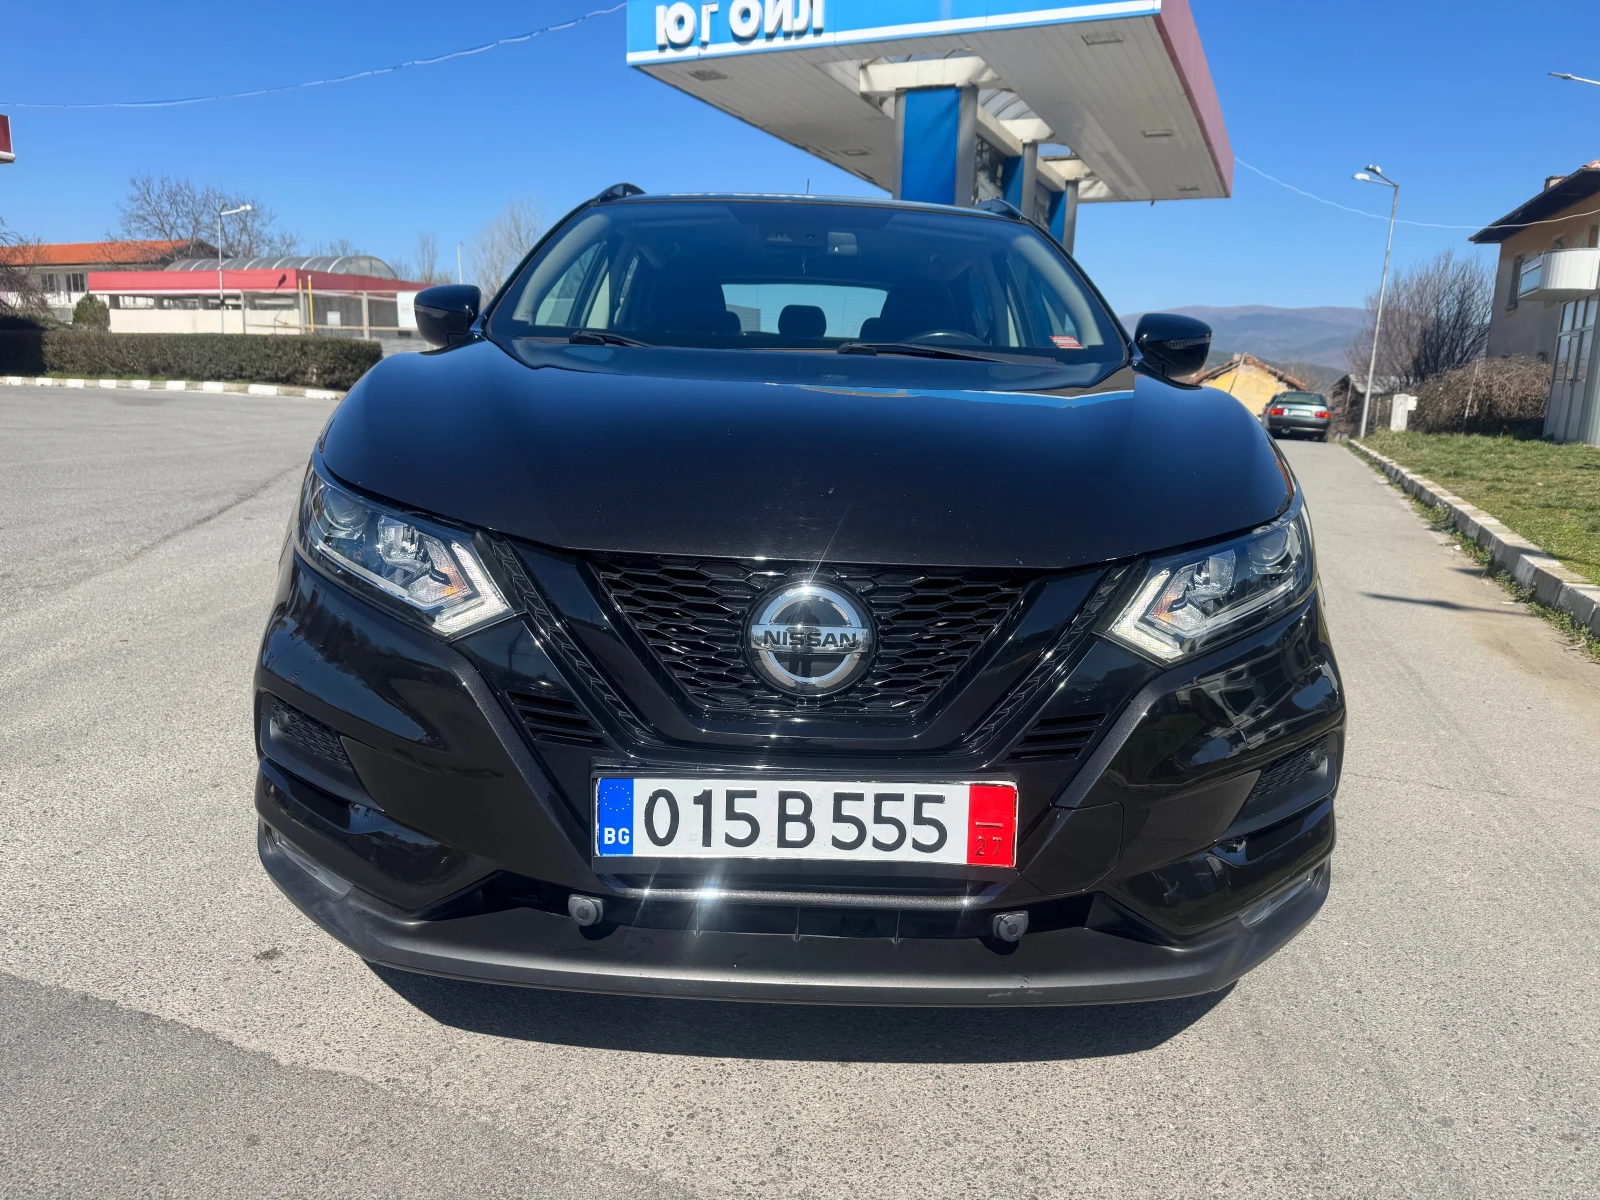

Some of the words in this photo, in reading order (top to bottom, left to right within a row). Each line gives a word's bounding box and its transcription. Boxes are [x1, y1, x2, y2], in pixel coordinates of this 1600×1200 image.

[656, 1, 719, 46] ЮГ
[729, 0, 824, 38] ОИЛ
[763, 630, 857, 648] NISSAN
[603, 827, 630, 845] BG
[975, 835, 1003, 857] 27
